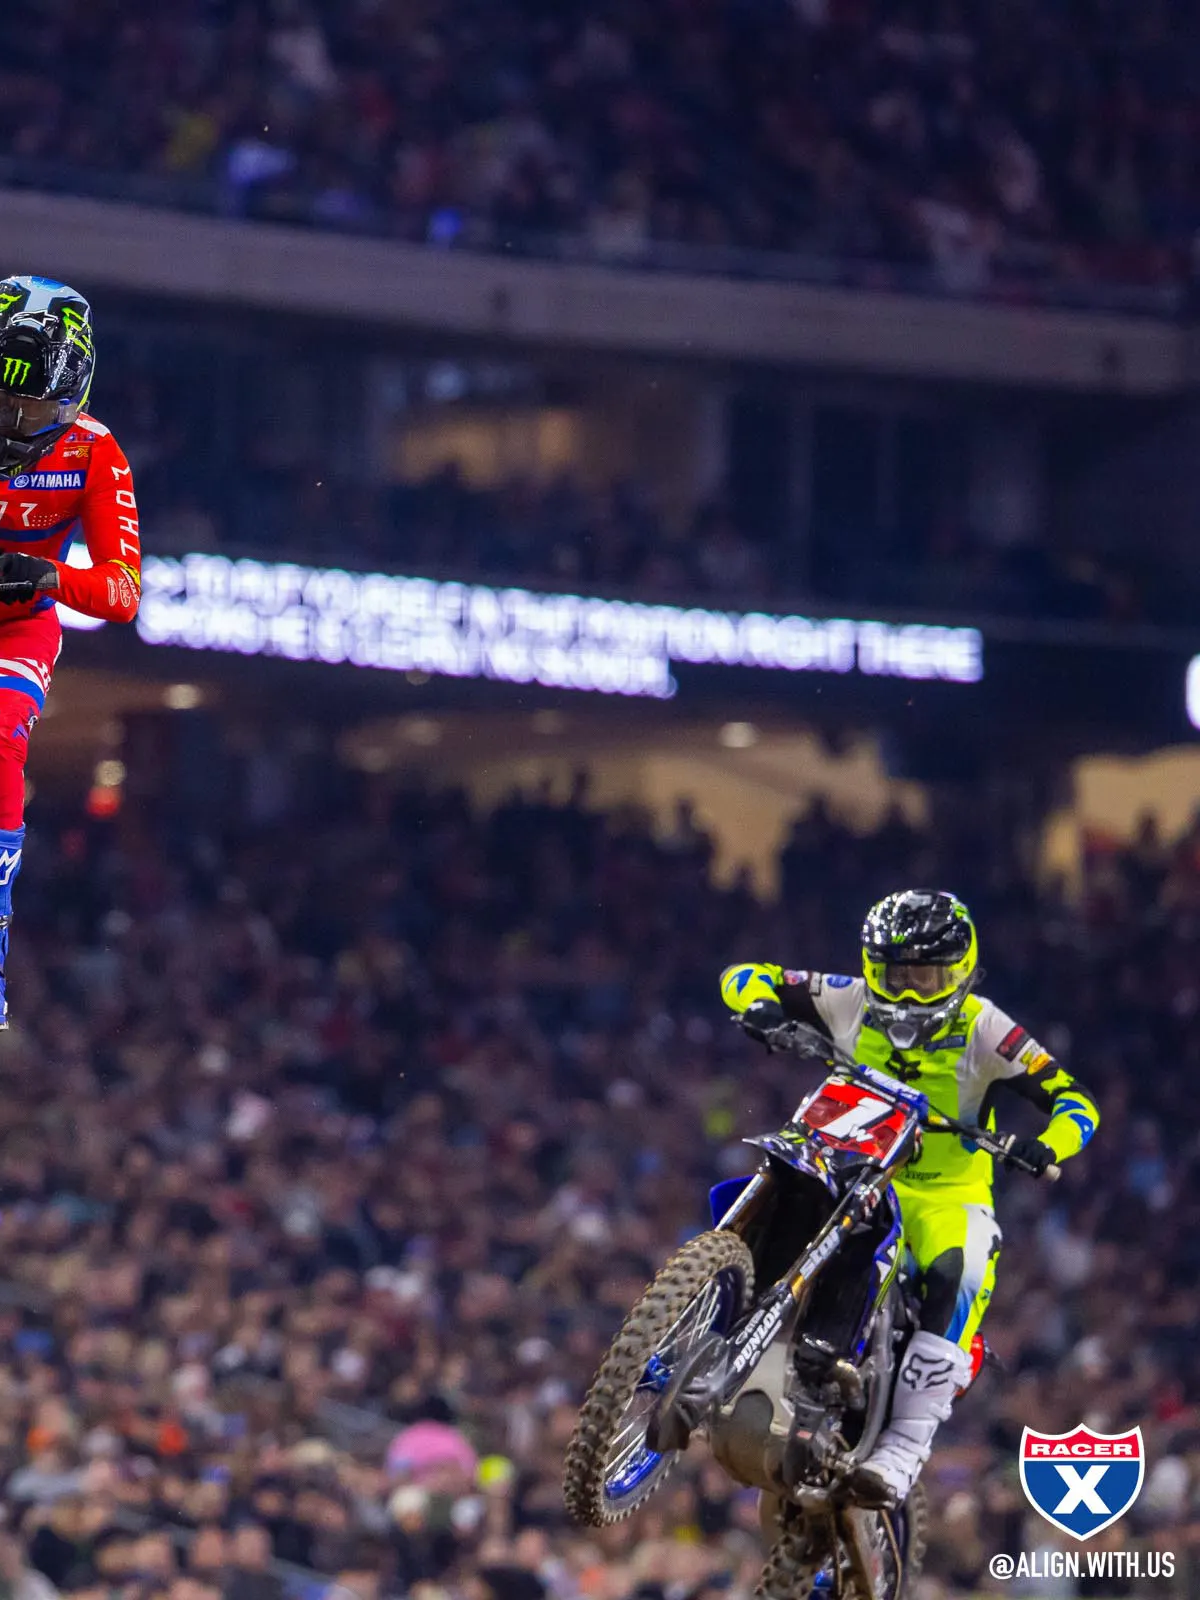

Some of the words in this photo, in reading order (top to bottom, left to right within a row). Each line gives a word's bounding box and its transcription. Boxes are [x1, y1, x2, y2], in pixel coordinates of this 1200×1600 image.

[30, 473, 82, 488] YAMAHA
[111, 465, 140, 557] THOR
[733, 1304, 785, 1373] DUNLOP
